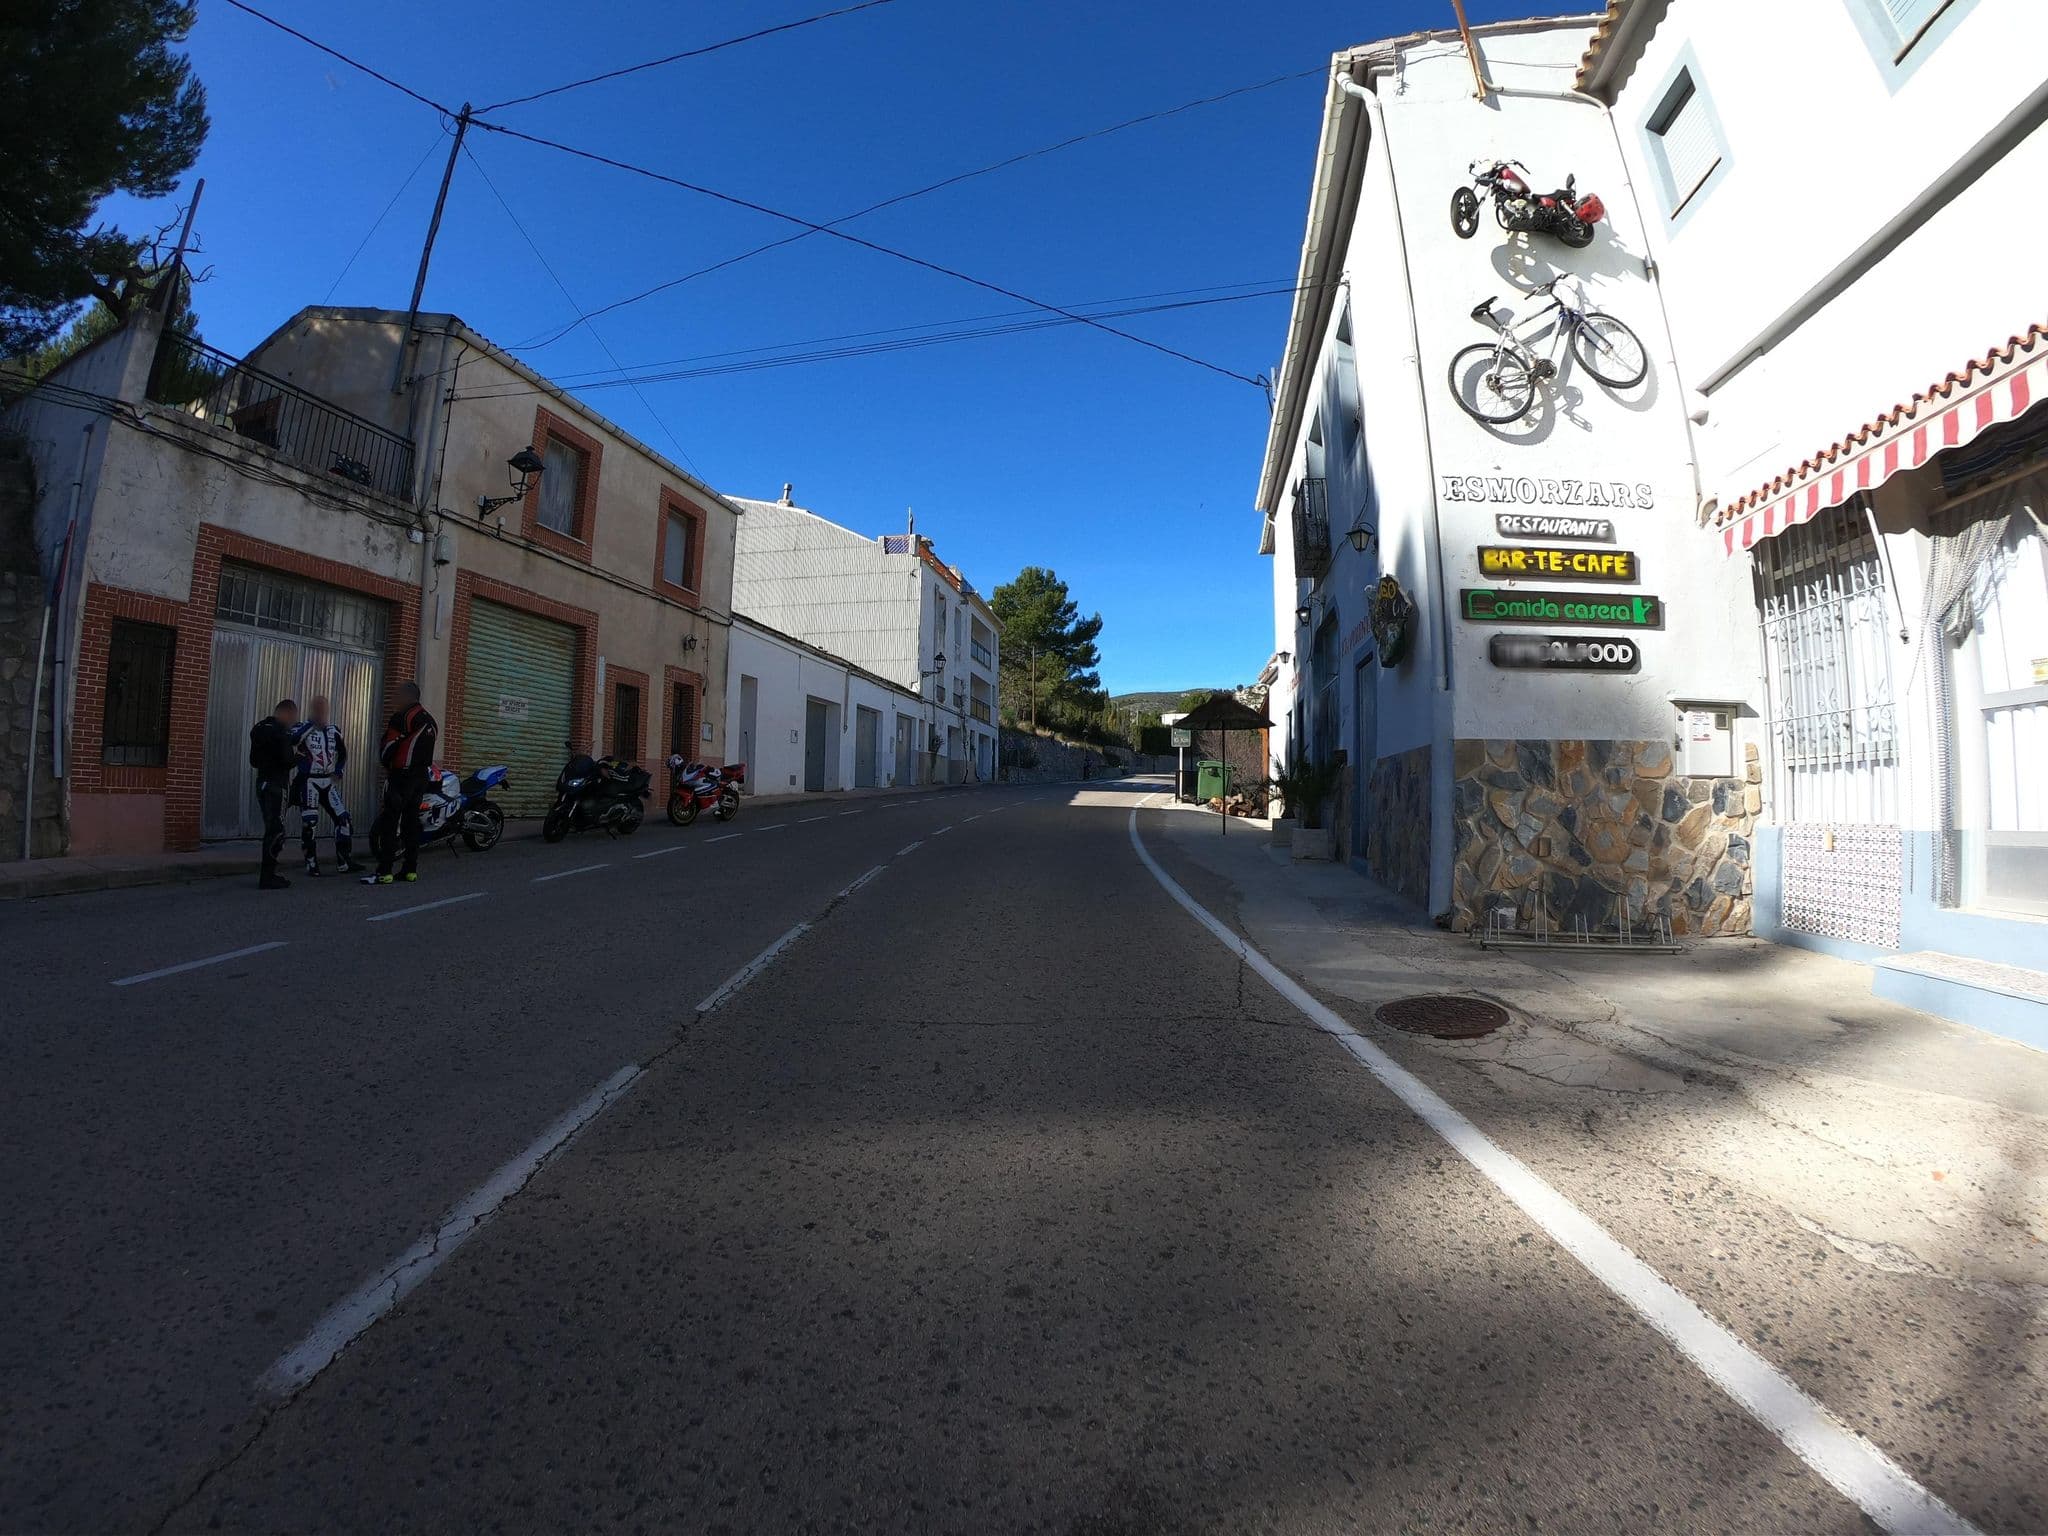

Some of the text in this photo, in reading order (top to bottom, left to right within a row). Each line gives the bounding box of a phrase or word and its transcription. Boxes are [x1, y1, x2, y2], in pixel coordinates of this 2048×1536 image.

[1442, 475, 1655, 510] ESMORZARS
[1499, 515, 1609, 538] RESTAURANTE
[1467, 590, 1632, 622] Comida casera
